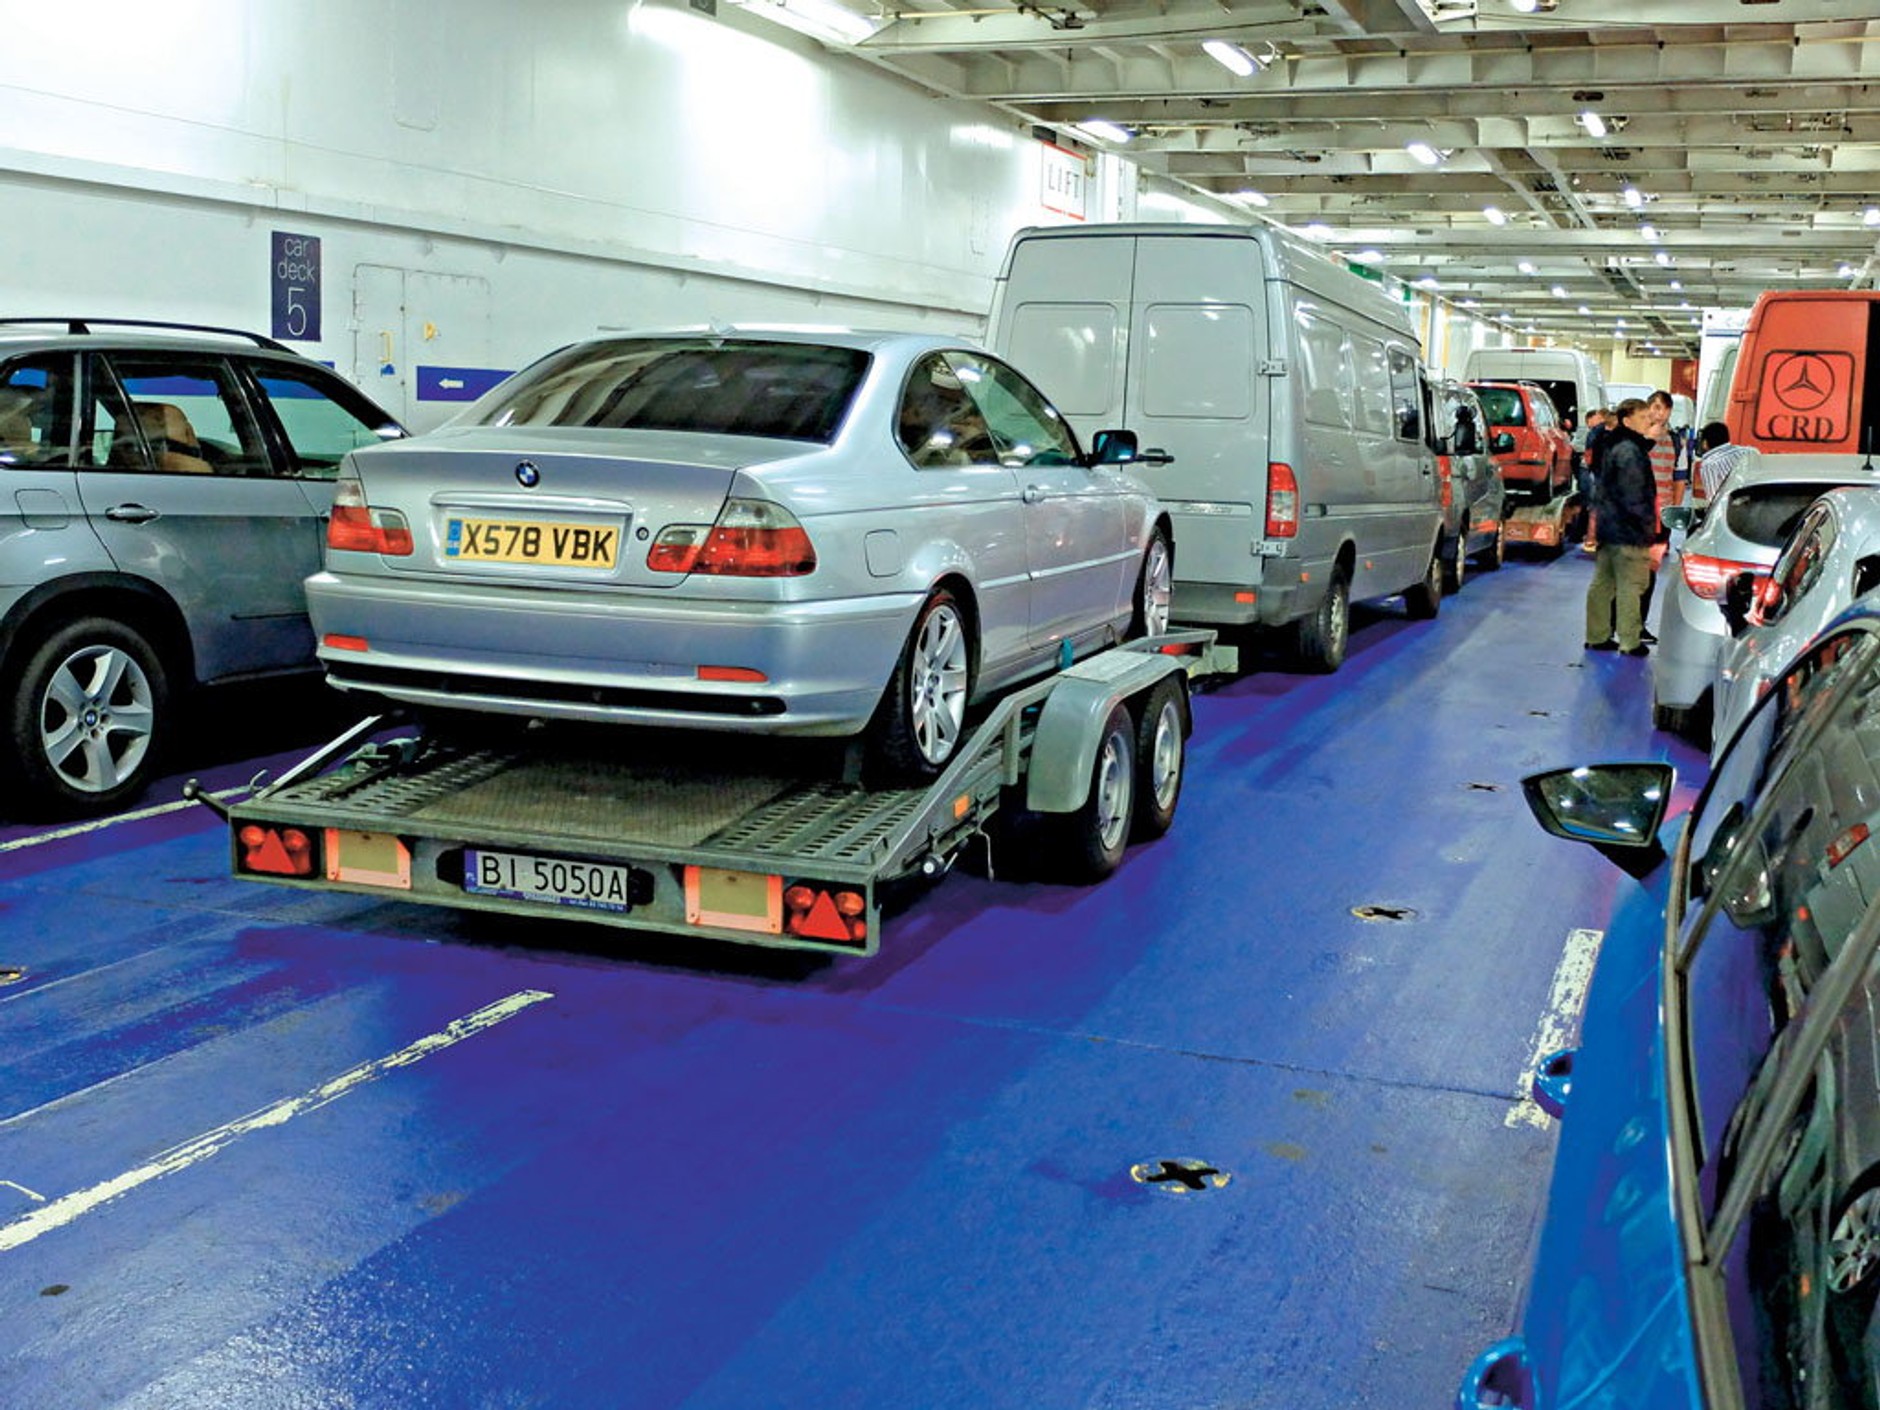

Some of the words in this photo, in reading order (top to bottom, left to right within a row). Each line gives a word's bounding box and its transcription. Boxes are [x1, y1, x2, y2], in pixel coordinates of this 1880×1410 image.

[1047, 163, 1081, 199] LIFT
[284, 238, 310, 257] car
[277, 256, 316, 283] deck
[287, 286, 307, 337] 5
[1767, 414, 1834, 441] CRD
[462, 523, 541, 558] X578
[552, 527, 614, 562] VBK
[482, 855, 516, 888] BI
[533, 861, 624, 901] 5050A
